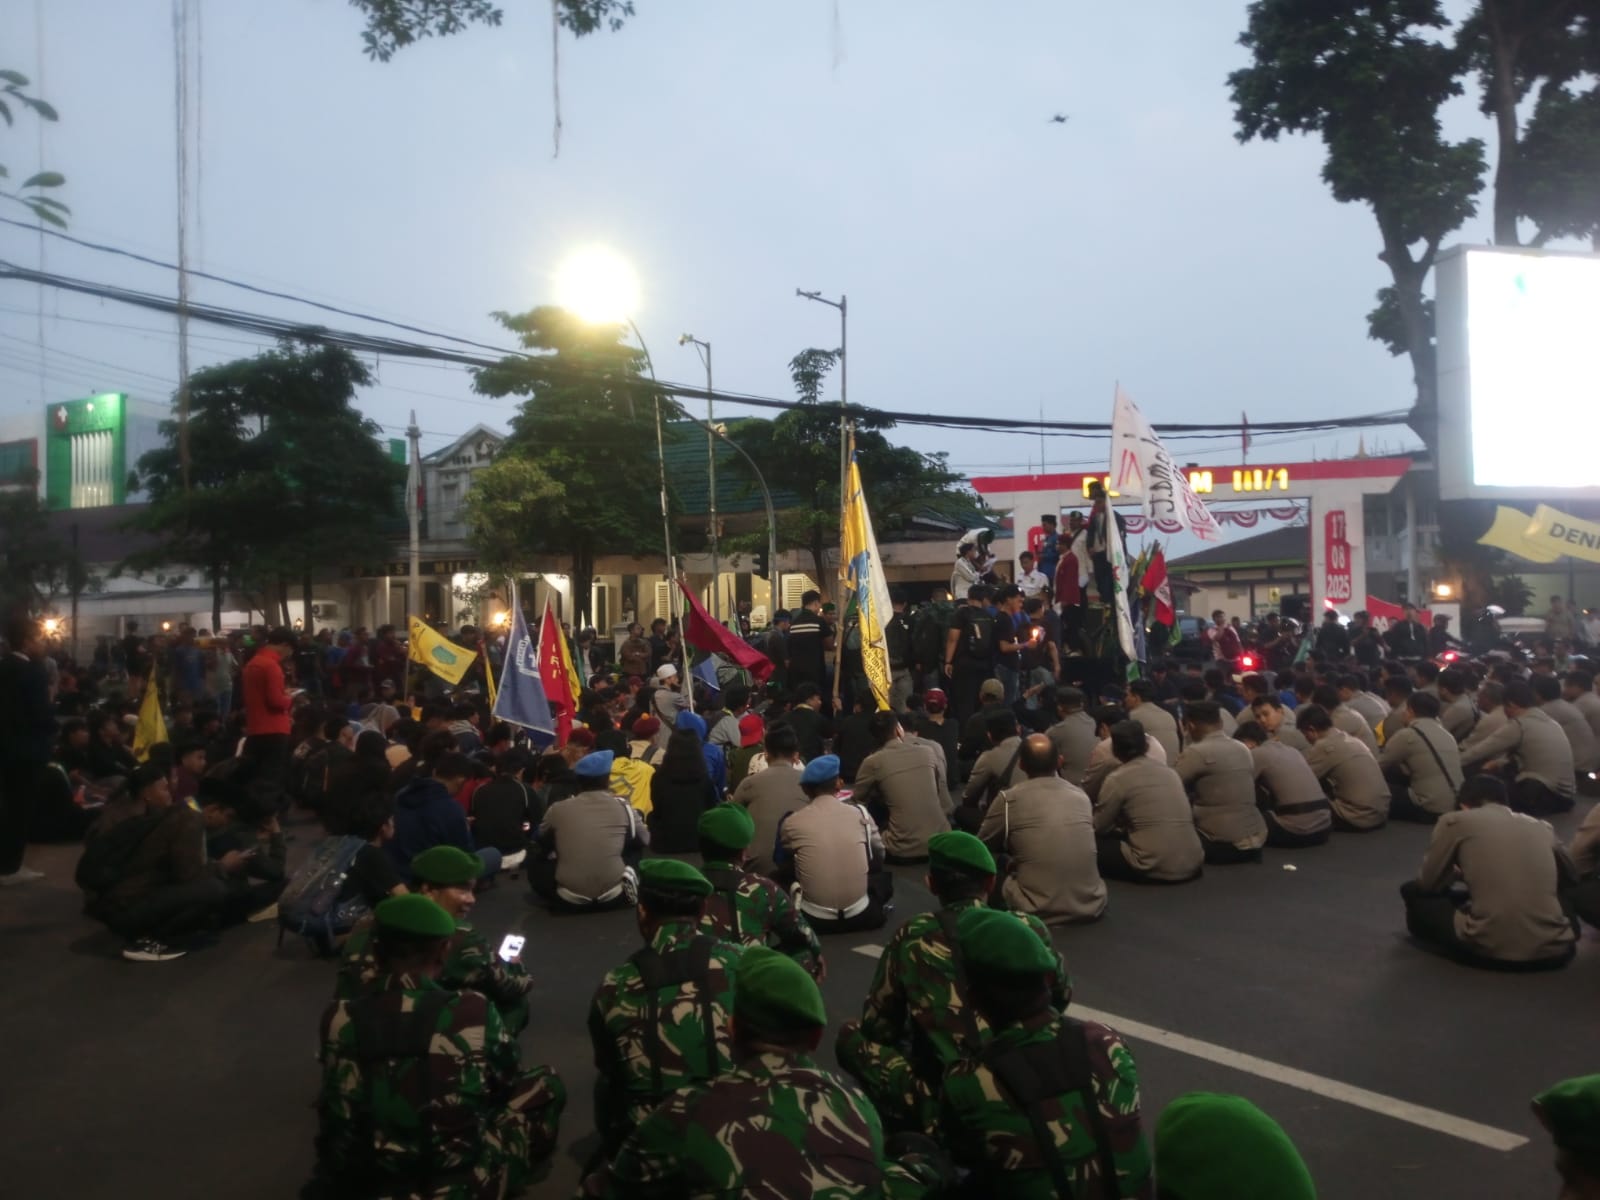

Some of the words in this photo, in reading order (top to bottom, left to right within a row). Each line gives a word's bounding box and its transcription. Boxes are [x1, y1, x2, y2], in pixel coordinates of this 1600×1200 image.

[1332, 515, 1345, 539] 17
[1331, 545, 1345, 569] 08
[1327, 574, 1350, 598] 2025
